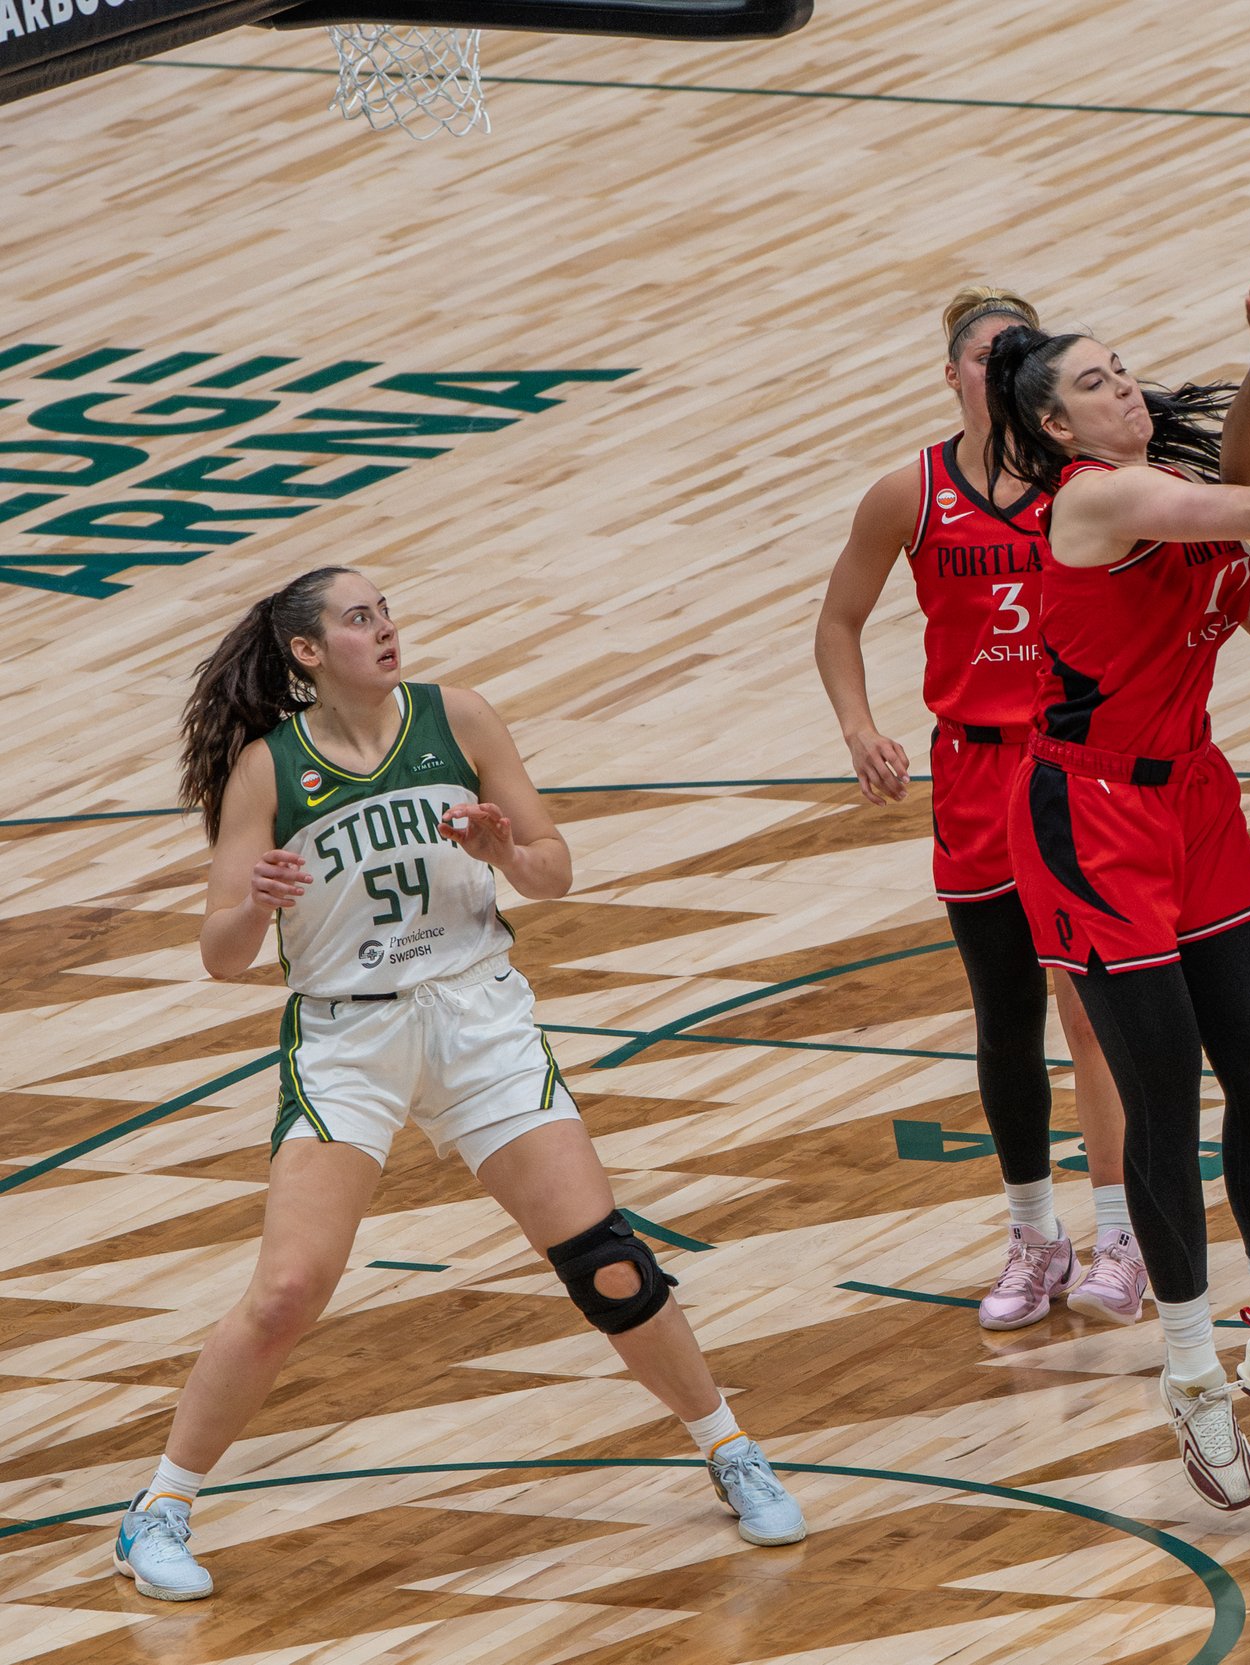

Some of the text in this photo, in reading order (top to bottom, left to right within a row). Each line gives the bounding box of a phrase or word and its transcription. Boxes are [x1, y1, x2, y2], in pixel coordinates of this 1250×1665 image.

[0, 368, 642, 600] ARENA
[937, 541, 1043, 577] PORTLA
[992, 582, 1030, 635] 3
[971, 644, 1042, 665] ASHIF
[412, 760, 445, 772] SYMETRA
[314, 798, 458, 884] STORM
[362, 857, 430, 926] 54
[389, 944, 432, 964] SWEDISH
[390, 926, 445, 948] Providence
